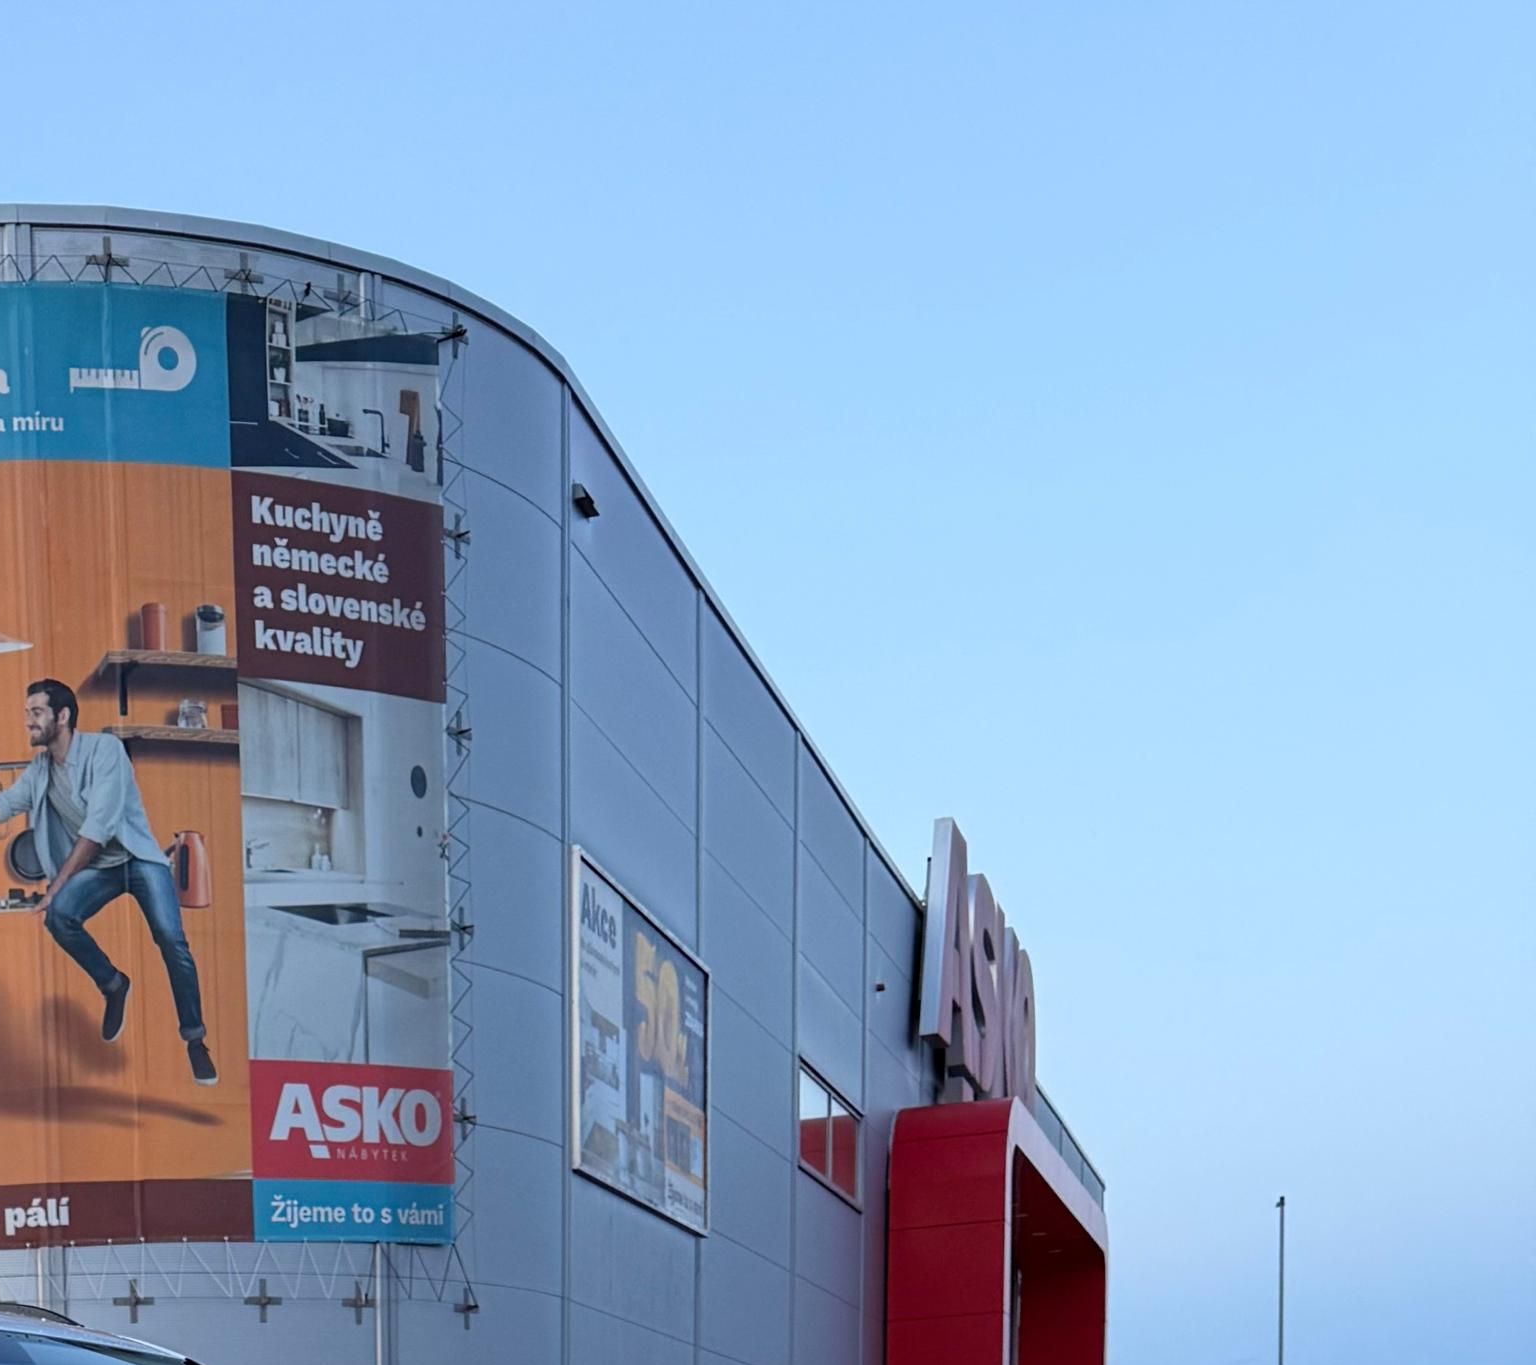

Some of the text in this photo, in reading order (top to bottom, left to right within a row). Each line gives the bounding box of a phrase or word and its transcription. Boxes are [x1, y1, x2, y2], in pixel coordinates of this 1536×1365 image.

[12, 410, 64, 433] míru
[251, 495, 384, 543] Kuchyně
[252, 537, 389, 584] německé
[253, 583, 426, 631] a slovenské
[254, 619, 364, 669] kvality
[581, 882, 617, 949] Akce
[269, 1082, 442, 1159] ASKO
[336, 1146, 408, 1162] NÁBYTEK
[4, 1196, 70, 1236] pálí
[271, 1194, 444, 1228] Žijeme to s vámi
